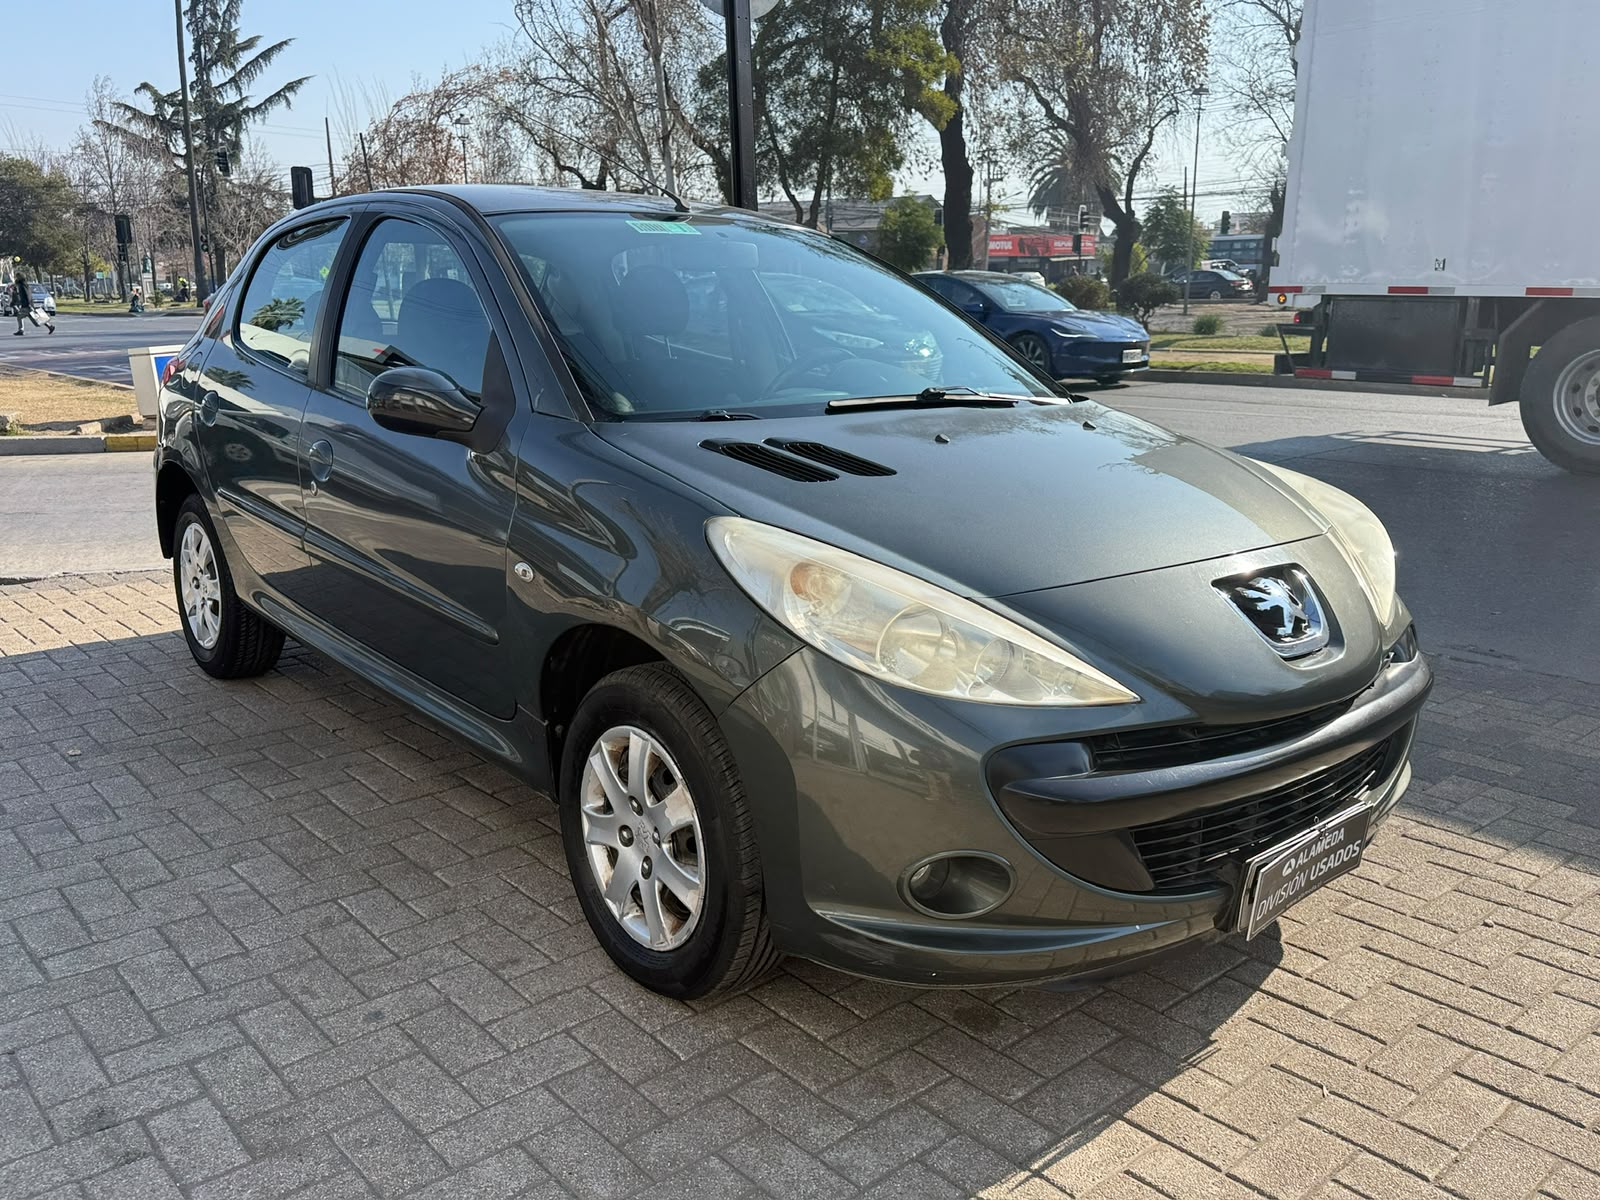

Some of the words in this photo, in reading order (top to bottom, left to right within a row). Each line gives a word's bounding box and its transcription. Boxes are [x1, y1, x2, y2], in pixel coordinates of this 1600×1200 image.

[988, 240, 1012, 250] MOTUL
[1296, 828, 1345, 869] ALAMEDA
[1256, 869, 1309, 921] DIVISIÓN
[1310, 840, 1362, 880] USADOS
